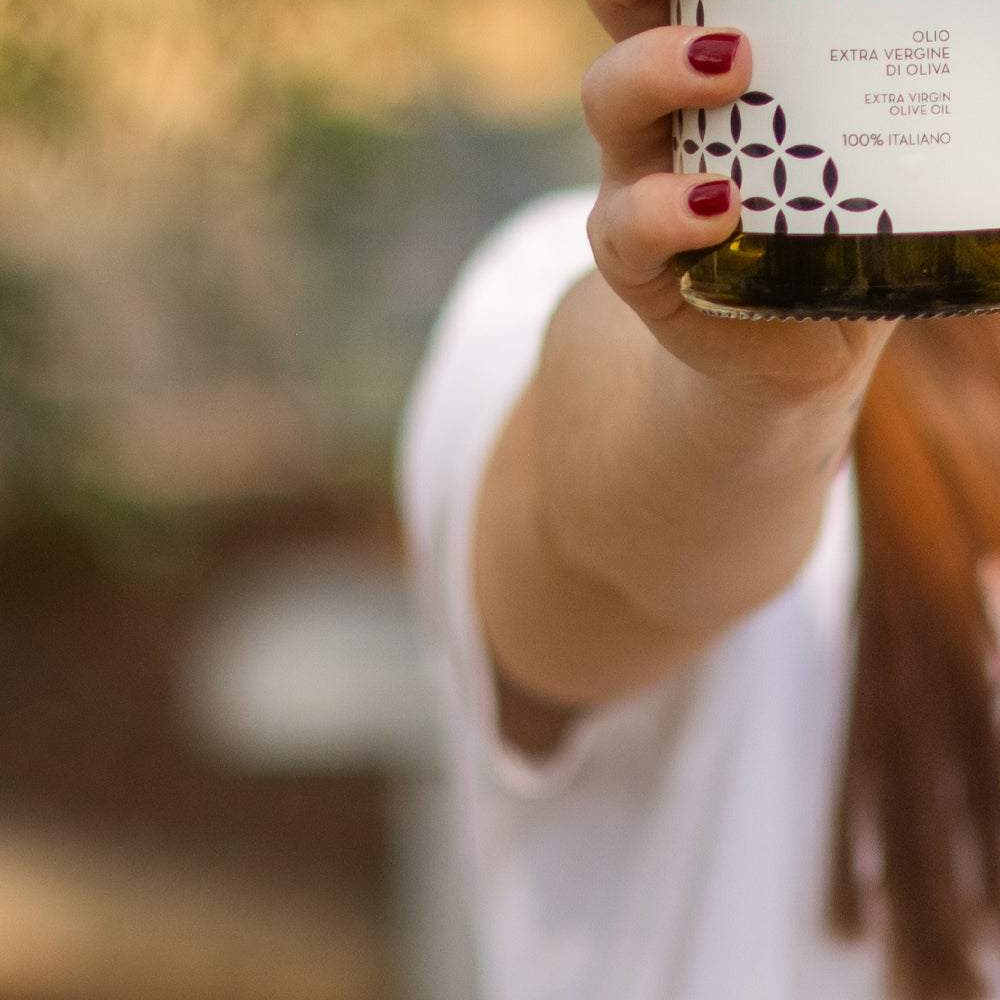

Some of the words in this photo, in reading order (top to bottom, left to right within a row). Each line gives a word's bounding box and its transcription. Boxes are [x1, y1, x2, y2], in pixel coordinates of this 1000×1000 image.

[912, 29, 950, 43] OLIO
[830, 49, 878, 62] EXTRA
[884, 46, 950, 60] VERGINE
[886, 64, 901, 76] DI
[906, 63, 951, 76] OLIVA
[864, 93, 905, 104] EXTRA
[909, 92, 951, 103] VIRGIN
[889, 104, 927, 116] OLIVE
[930, 104, 951, 115] OIL
[842, 133, 884, 147] 100%
[888, 132, 951, 146] ITALIANO
